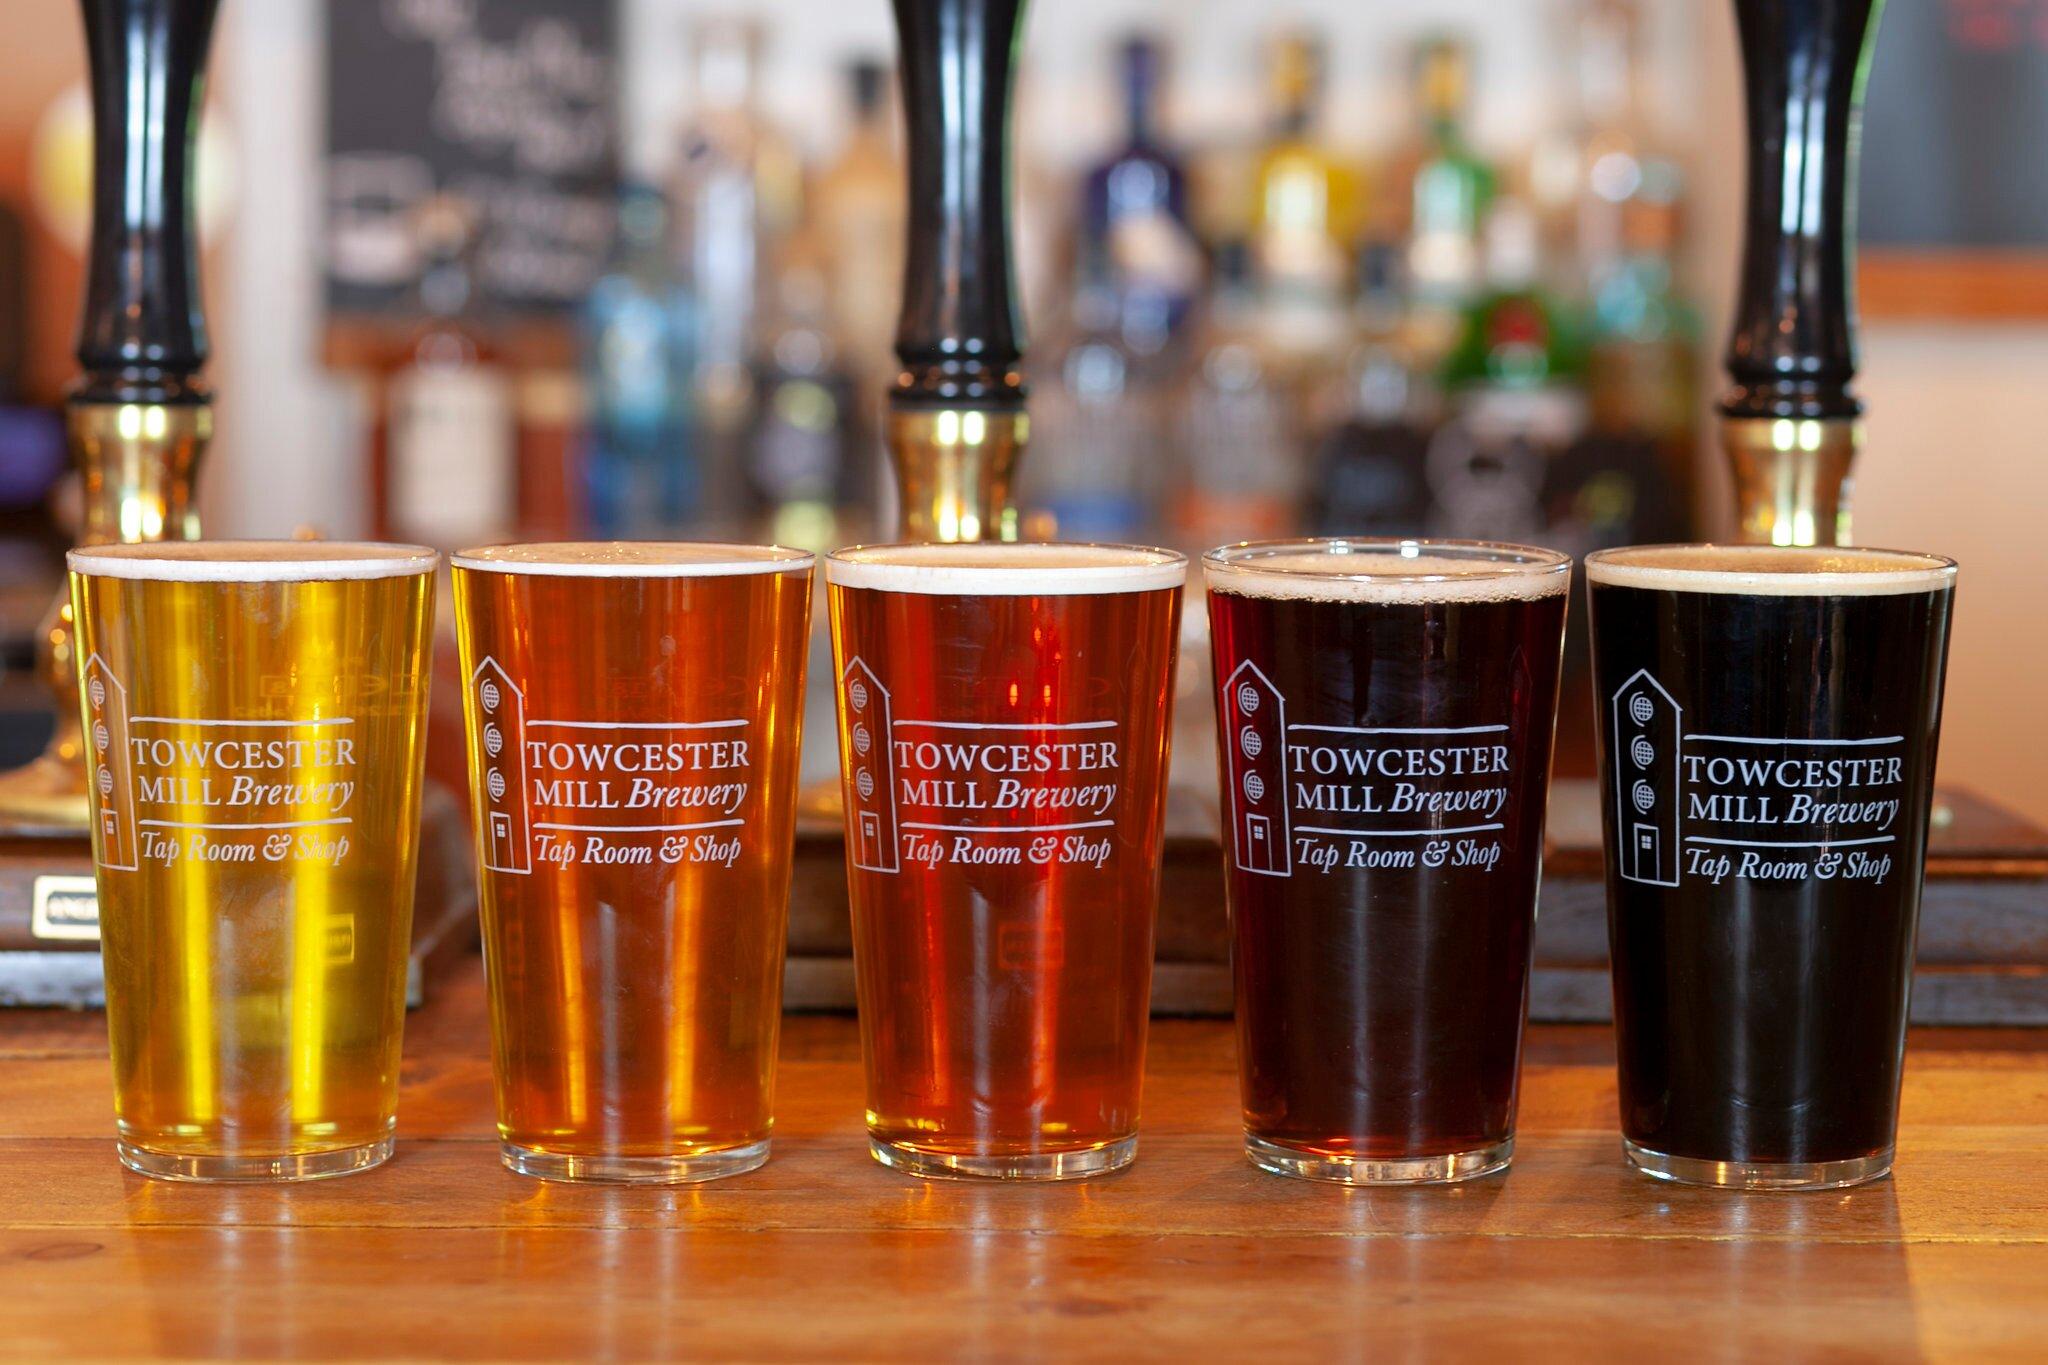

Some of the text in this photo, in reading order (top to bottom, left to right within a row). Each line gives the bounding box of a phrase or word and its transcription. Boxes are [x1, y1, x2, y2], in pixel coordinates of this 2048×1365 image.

[131, 737, 355, 769] TOWCESTER
[527, 740, 749, 771] TOWCESTER
[894, 741, 1119, 772] TOWCESTER
[1288, 745, 1509, 776] TOWCESTER
[1684, 756, 1902, 788] TOWCESTER
[138, 775, 354, 812] MILL Brewery
[533, 779, 748, 814] MILL Brewery
[902, 779, 1117, 816] MILL Brewery
[1295, 783, 1507, 819] MILL Brewery
[1688, 793, 1899, 831] MILL Brewery
[141, 831, 349, 867] Tap Room & Shop
[534, 834, 741, 870] Tap Room & Shop
[903, 834, 1111, 870] Tap Room & Shop
[1296, 838, 1500, 874] Tap Room & Shop
[1686, 848, 1891, 885] Tap Room & Shop
